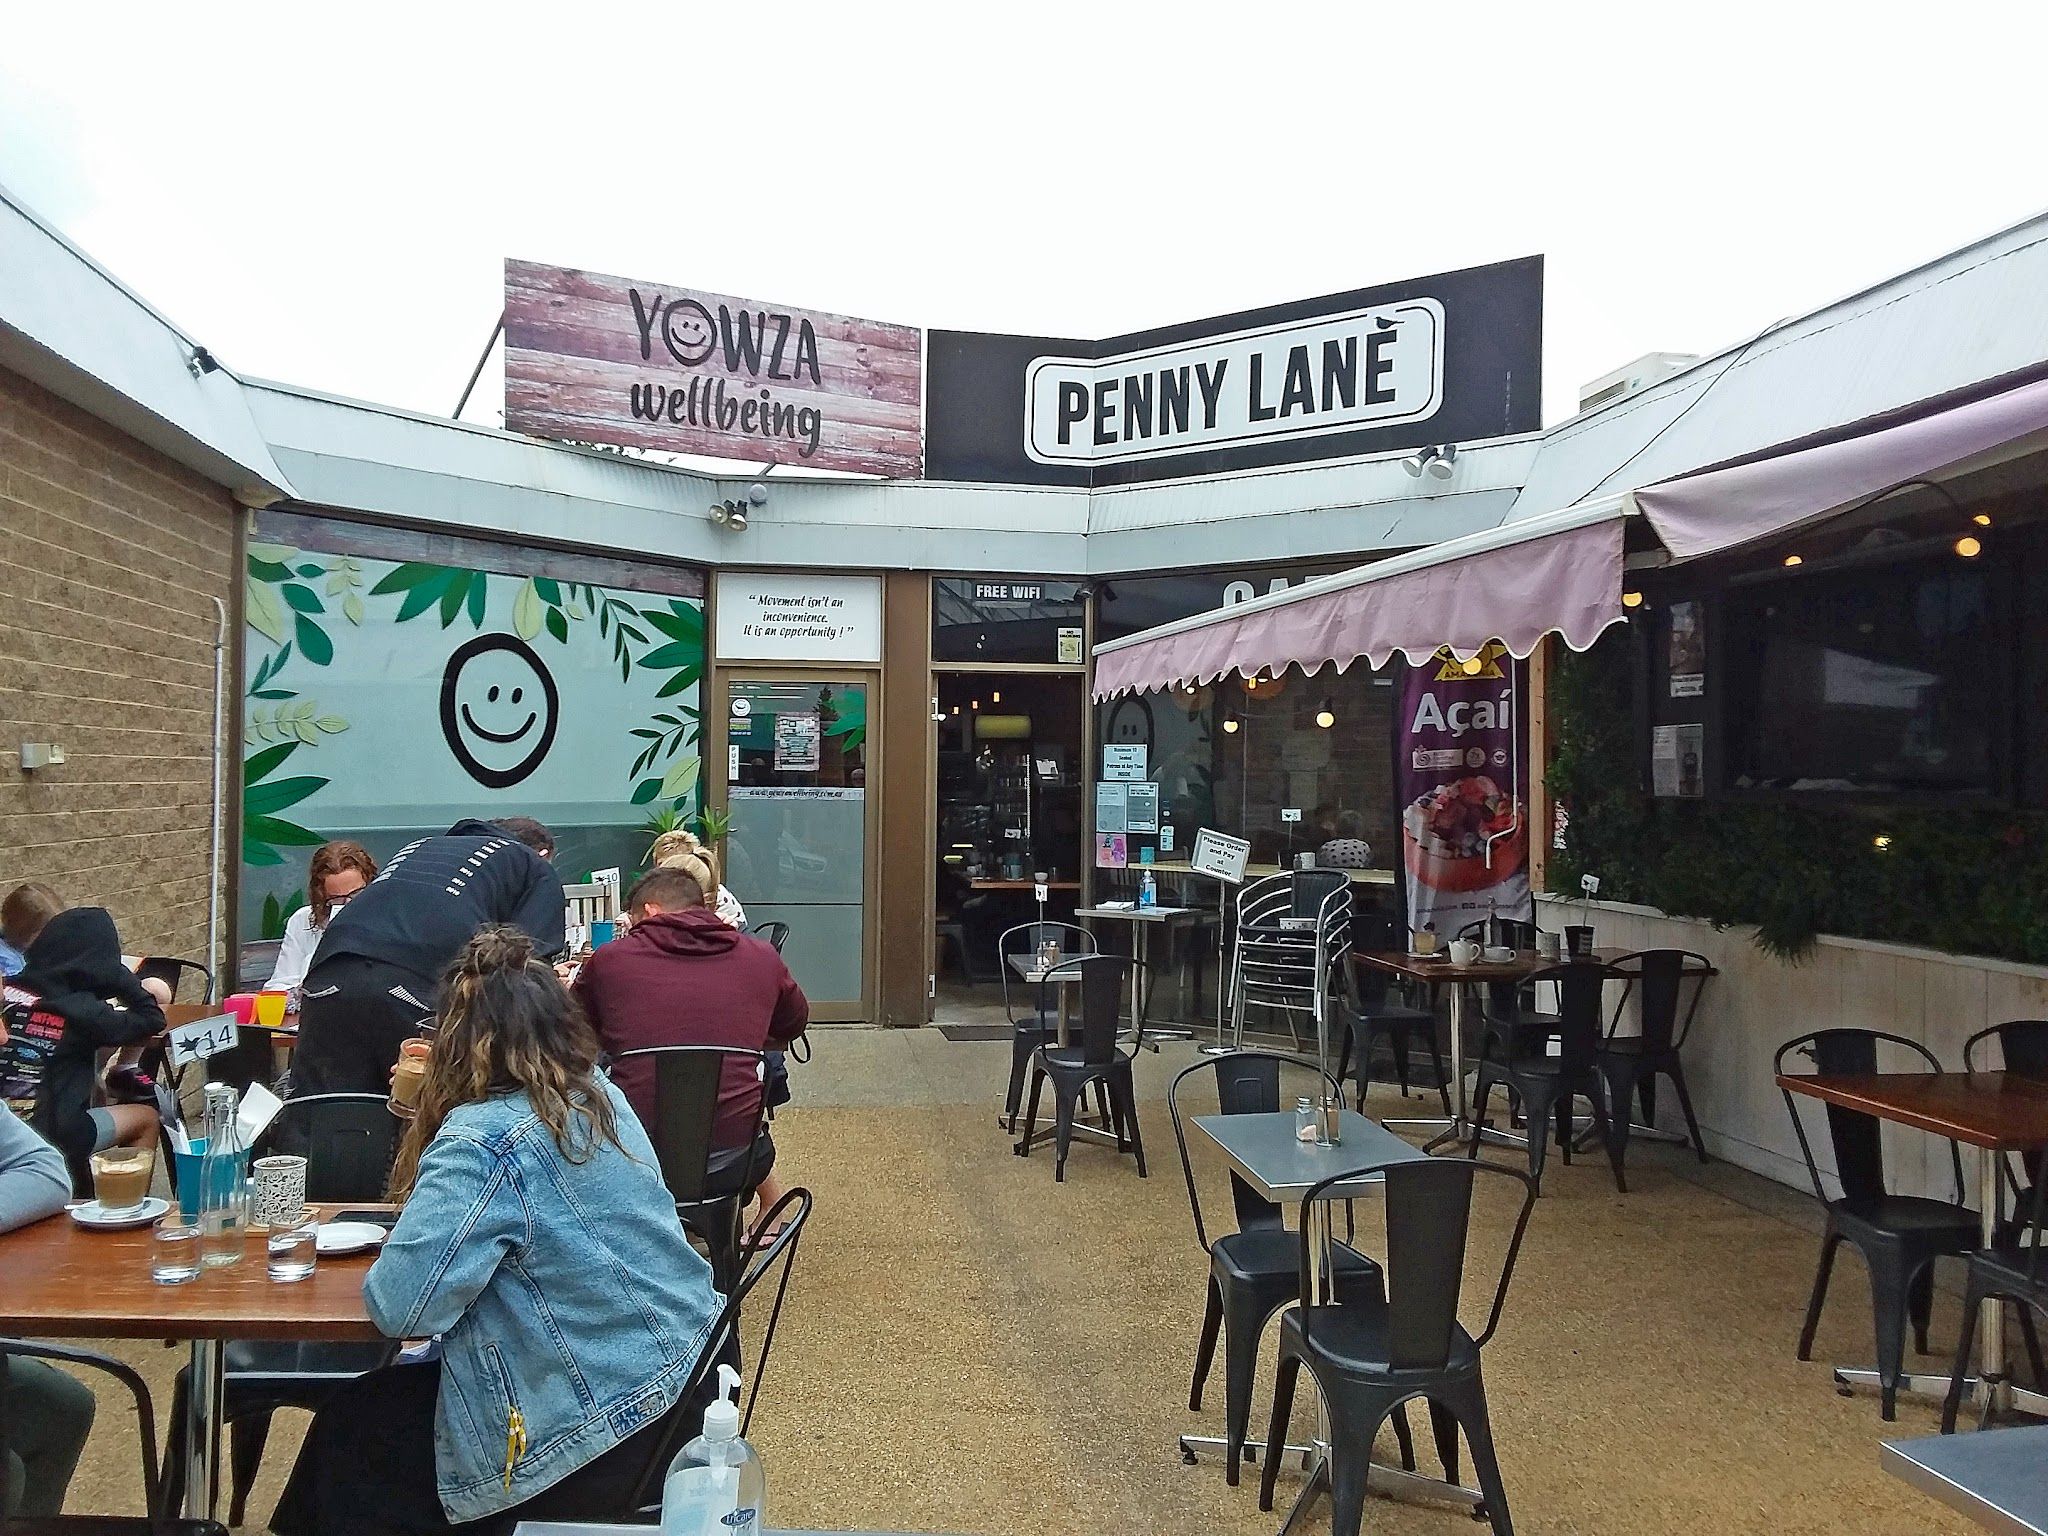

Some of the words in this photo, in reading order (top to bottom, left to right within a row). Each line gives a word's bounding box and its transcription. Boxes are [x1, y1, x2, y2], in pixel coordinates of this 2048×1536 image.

[629, 288, 821, 386] YOWZA
[1057, 358, 1228, 446] PENNY
[630, 376, 821, 459] wellbeing
[976, 584, 1008, 599] FREE
[1011, 585, 1041, 600] WIFI
[831, 598, 843, 608] an
[743, 624, 752, 636] It
[754, 624, 763, 637] is
[764, 626, 777, 636] an
[1411, 689, 1512, 738] Açaí
[1203, 836, 1225, 847] Please
[1226, 842, 1245, 853] Order
[1223, 851, 1235, 860] Pay
[1205, 864, 1232, 877] Counter
[204, 1025, 234, 1050] 14
